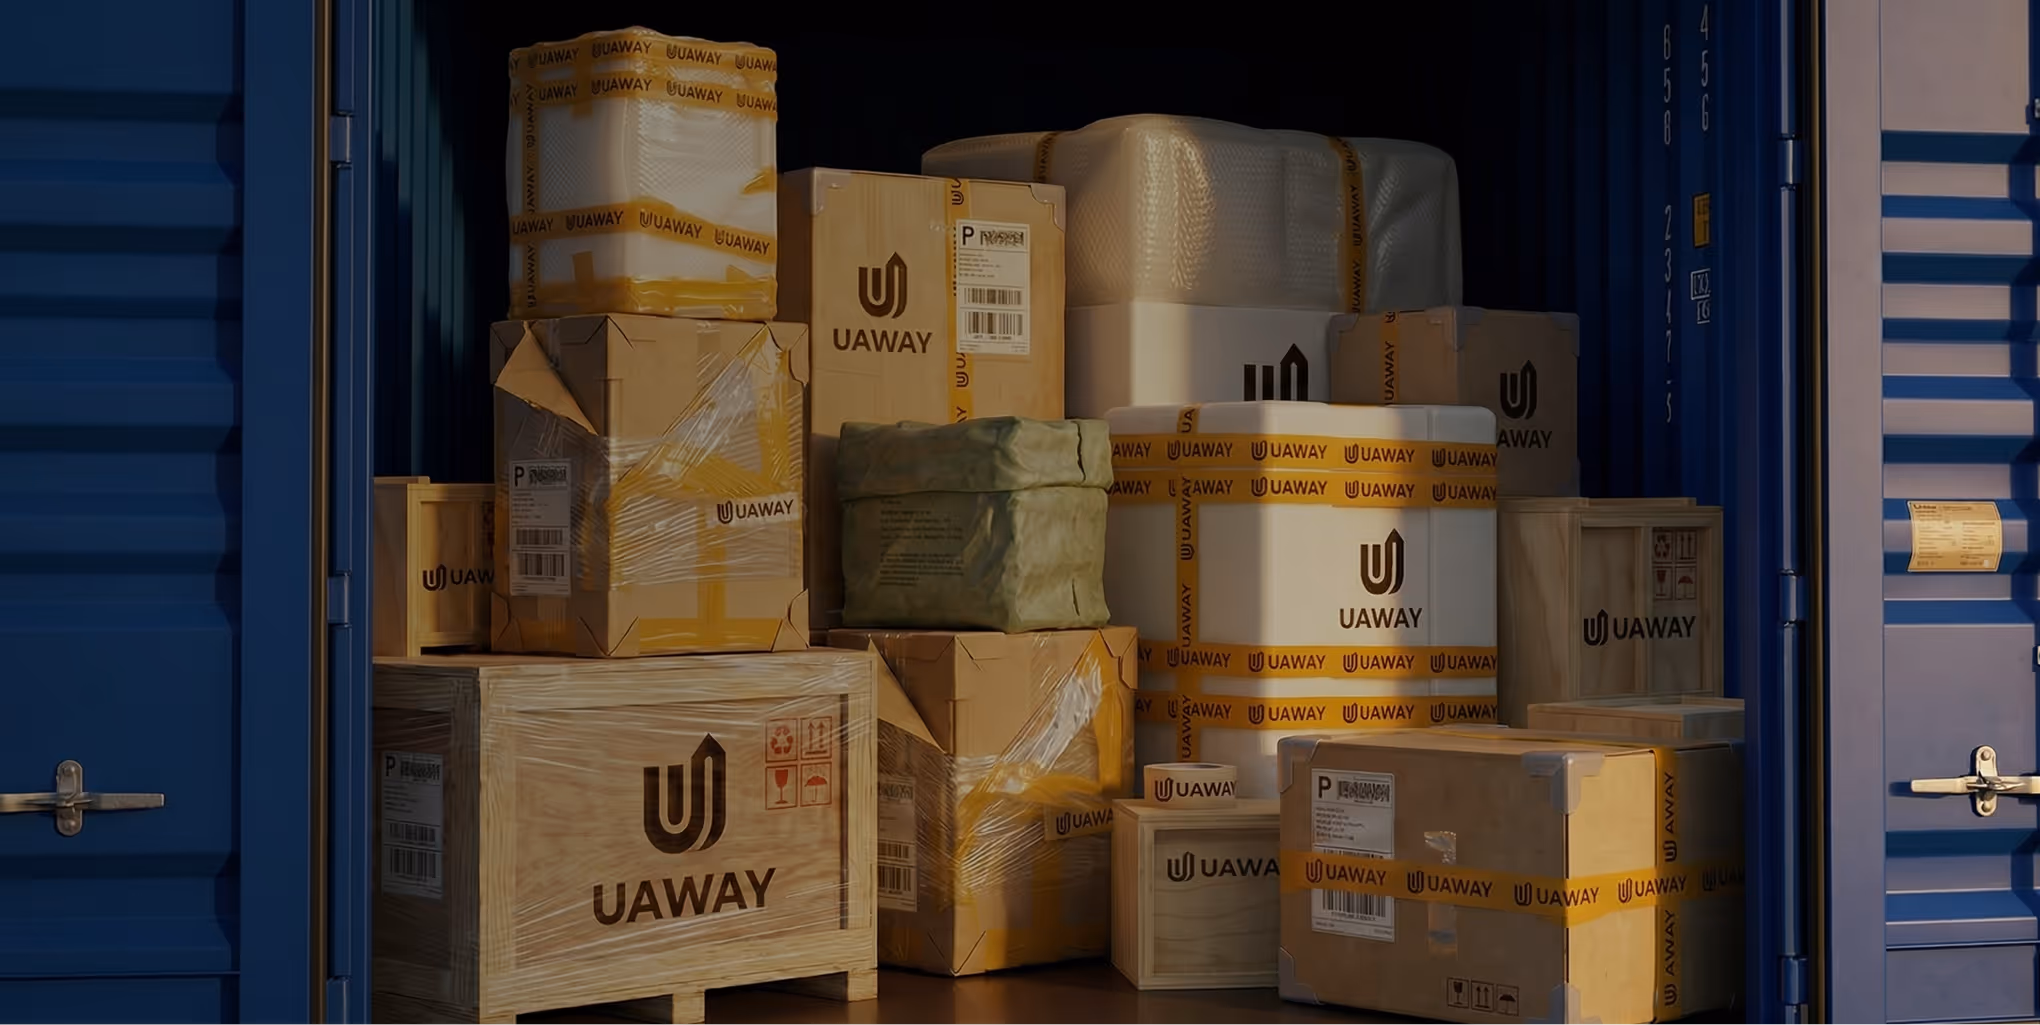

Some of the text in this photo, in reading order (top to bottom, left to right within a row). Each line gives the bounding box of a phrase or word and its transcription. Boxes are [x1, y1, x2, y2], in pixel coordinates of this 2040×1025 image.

[539, 47, 579, 65] UAWAY
[603, 40, 652, 56] UAWAY
[678, 47, 721, 66] UAWAY
[1700, 4, 1709, 131] 456
[539, 83, 577, 102] UAWAY
[602, 79, 652, 93] UAWAY
[678, 86, 723, 103] UAWAY
[1350, 184, 1361, 233] UAWAY
[512, 210, 770, 255] UAWAY UAWAY UAWAY UAWAY
[962, 226, 974, 245] P
[1352, 259, 1361, 308] UAWAY
[833, 328, 933, 353] UAWAY
[1385, 341, 1395, 400] UAWAY
[1182, 442, 1233, 458] UAWAY
[1271, 443, 1327, 459] UAWAY
[1362, 448, 1415, 463] UAWAY
[1448, 451, 1498, 467] UAWAY
[515, 466, 524, 486] P
[1271, 481, 1327, 496] UAWAY
[1362, 484, 1415, 499] UAWAY
[1448, 486, 1497, 501] UAWAY
[736, 499, 794, 519] UAWAY
[1182, 476, 1192, 541] UAWAY
[1182, 583, 1191, 648] UAWAY
[1340, 607, 1422, 629] UAWAY
[1614, 615, 1696, 640] UAWAY
[1181, 650, 1231, 668] UAWAY
[1268, 655, 1326, 670] UAWAY
[1361, 655, 1414, 670] UAWAY
[1448, 655, 1497, 670] UAWAY
[1268, 706, 1326, 721] UAWAY
[1361, 704, 1414, 720] UAWAY
[1448, 704, 1497, 719] UAWAY
[1182, 695, 1191, 759] UAWAY
[386, 756, 395, 776] P
[1319, 776, 1331, 798] P
[593, 867, 776, 925] UAWAY
[1326, 864, 1386, 886] UAWAY
[1428, 876, 1492, 897] UAWAY
[1537, 887, 1599, 907] UAWAY
[1635, 876, 1686, 897] UAWAY
